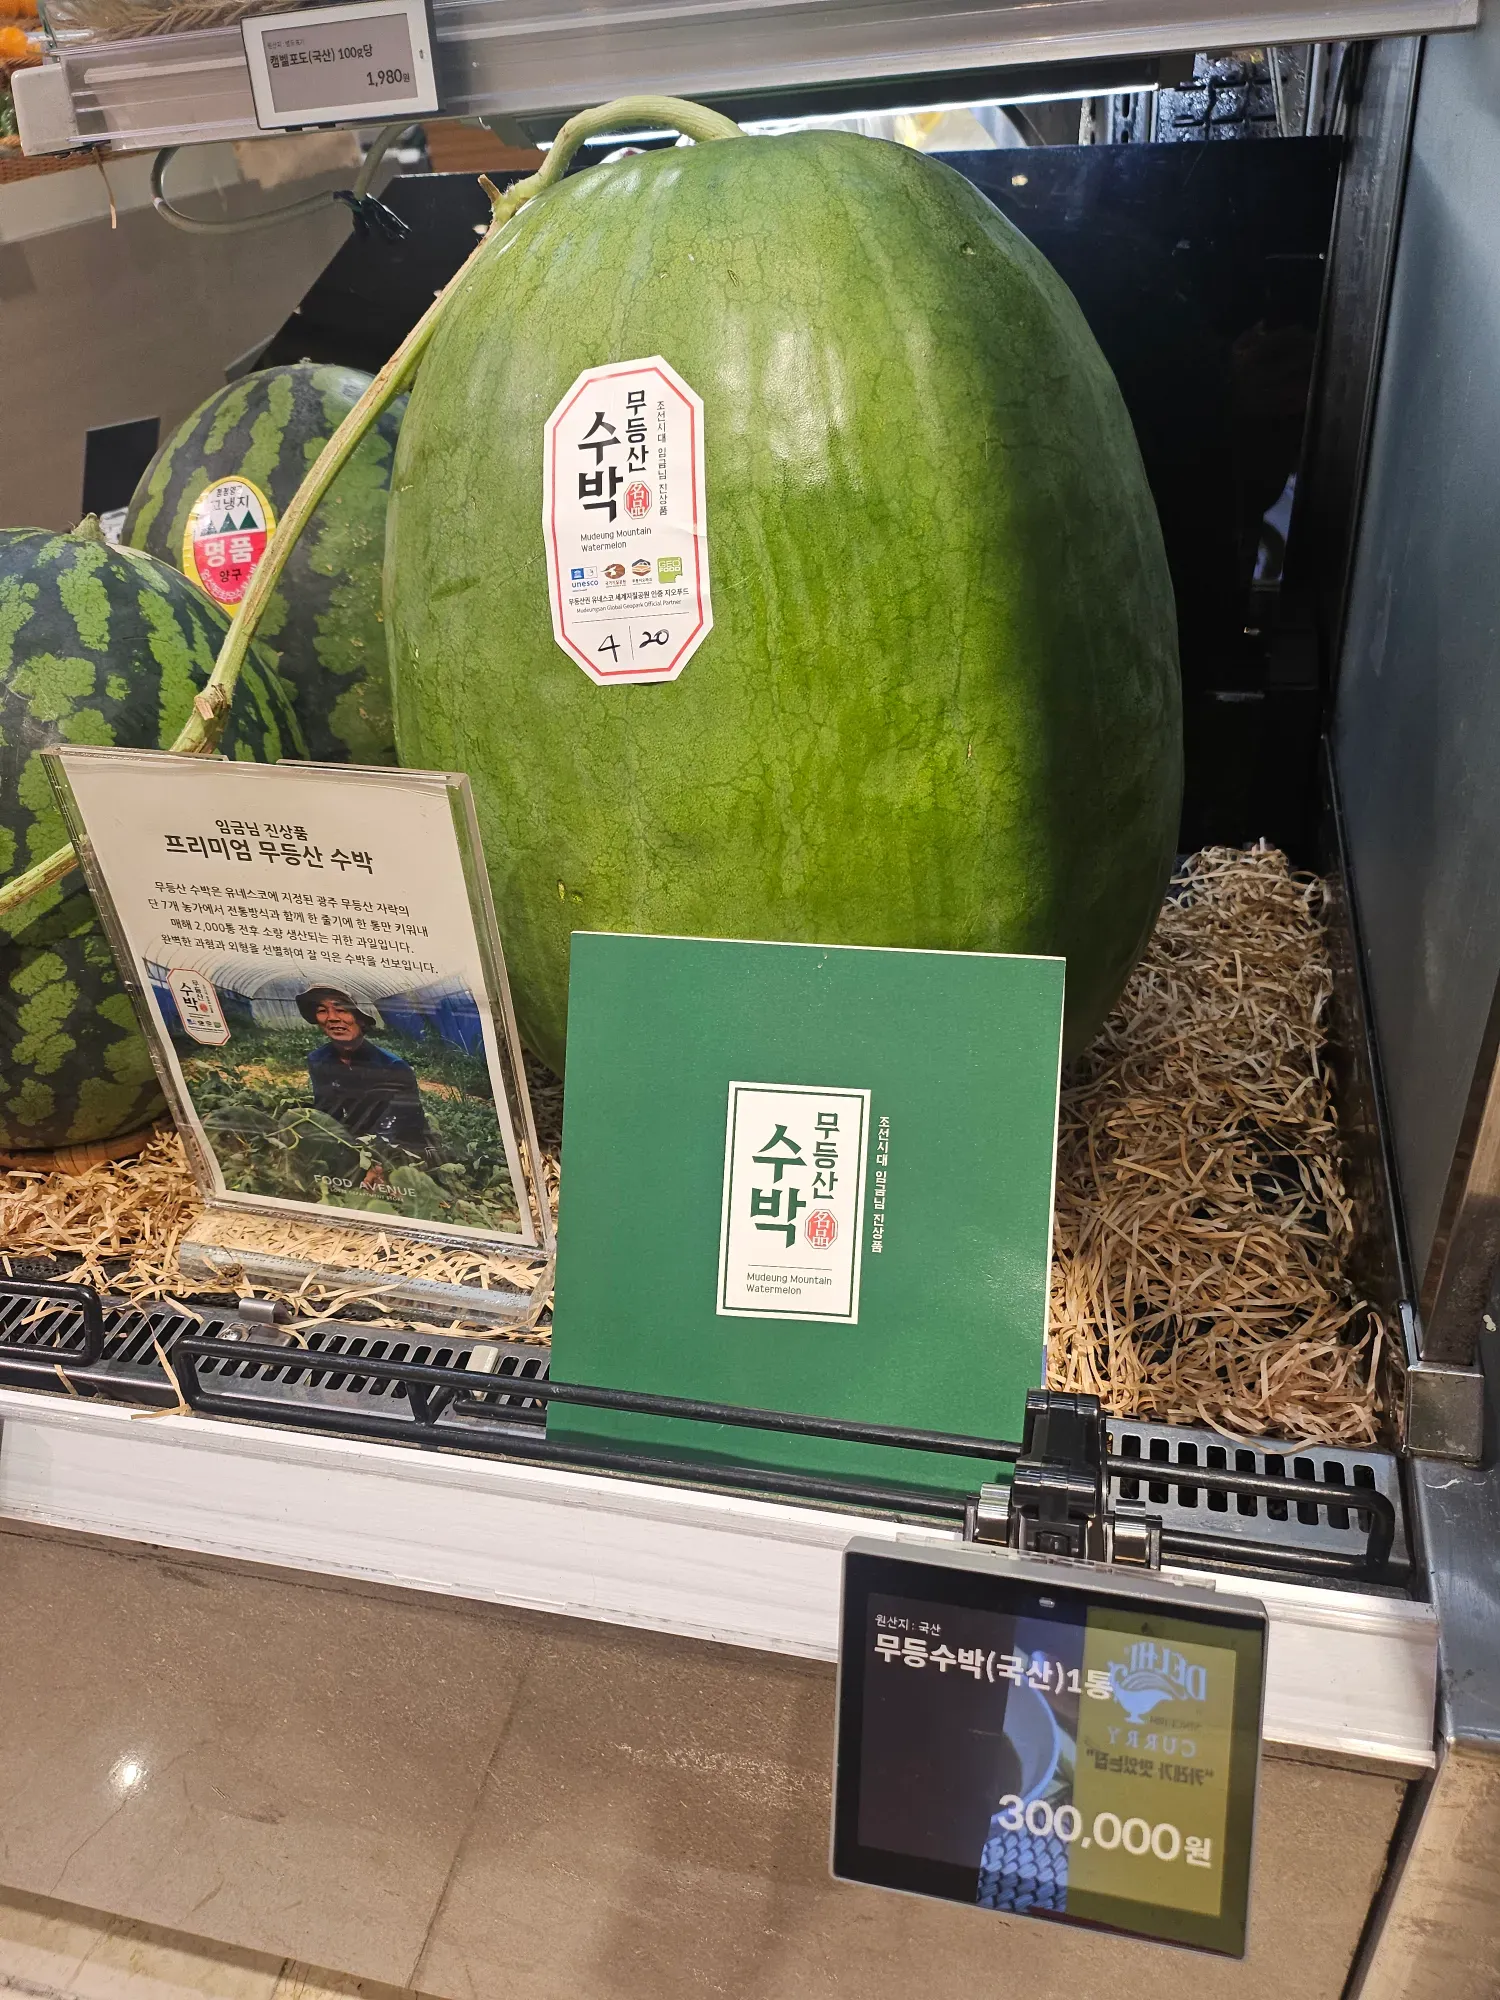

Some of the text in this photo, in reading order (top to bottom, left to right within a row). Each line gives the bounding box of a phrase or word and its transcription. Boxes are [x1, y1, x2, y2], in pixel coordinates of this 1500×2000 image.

[270, 44, 373, 68] 캠벨포도(국산) 100g당
[366, 69, 410, 87] 1,980원
[625, 390, 649, 473] 무등산
[577, 412, 623, 523] 수박
[657, 400, 668, 516] 조선시대 임금님 진상품
[629, 483, 646, 517] 名品
[580, 527, 652, 542] Mudeung Mountain
[581, 541, 627, 552] Watermelon
[204, 537, 254, 567] 명품
[658, 560, 681, 568] GEO
[220, 569, 242, 583] 양구
[571, 580, 599, 588] unesco
[591, 594, 614, 603] 유네스코
[615, 591, 650, 600] 세계지질공원
[651, 590, 663, 598] 인증
[665, 588, 689, 596] 지오푸드
[623, 602, 643, 610] Geopark
[597, 628, 670, 663] 4 20
[215, 819, 308, 841] 임금님 진상품
[164, 834, 373, 874] 프리미엄 무등산 수박
[155, 882, 410, 917] 무등산 수박은 유네스코에 지정된 광주 무등산 자락의
[148, 898, 429, 938] 단 7개 농가에서 전통방식과 함께 한 줄기에 한 통만 키워내
[170, 919, 414, 954] 매해 2,000통 전후 소량 생산되는 귀한 과일입니다.
[161, 934, 439, 974] 완벽한 과형과 외형을 선별하여 잘 익은 수박을 선보입니다.
[180, 982, 198, 1011] 수박
[811, 1111, 840, 1200] 무등산
[313, 1174, 417, 1197] FOOD AVENUE
[750, 1123, 808, 1249] 수박
[871, 1116, 890, 1253] 조선시대 임금님 진상품
[811, 1210, 831, 1248] 名品
[746, 1272, 833, 1286] Mudeung Mountain
[746, 1284, 802, 1295] Watermelon
[875, 1614, 909, 1631] 원산지
[918, 1621, 941, 1637] 국산
[874, 1633, 1113, 1700] 무등수박(국산)1통
[997, 1794, 1212, 1869] 300,000원
